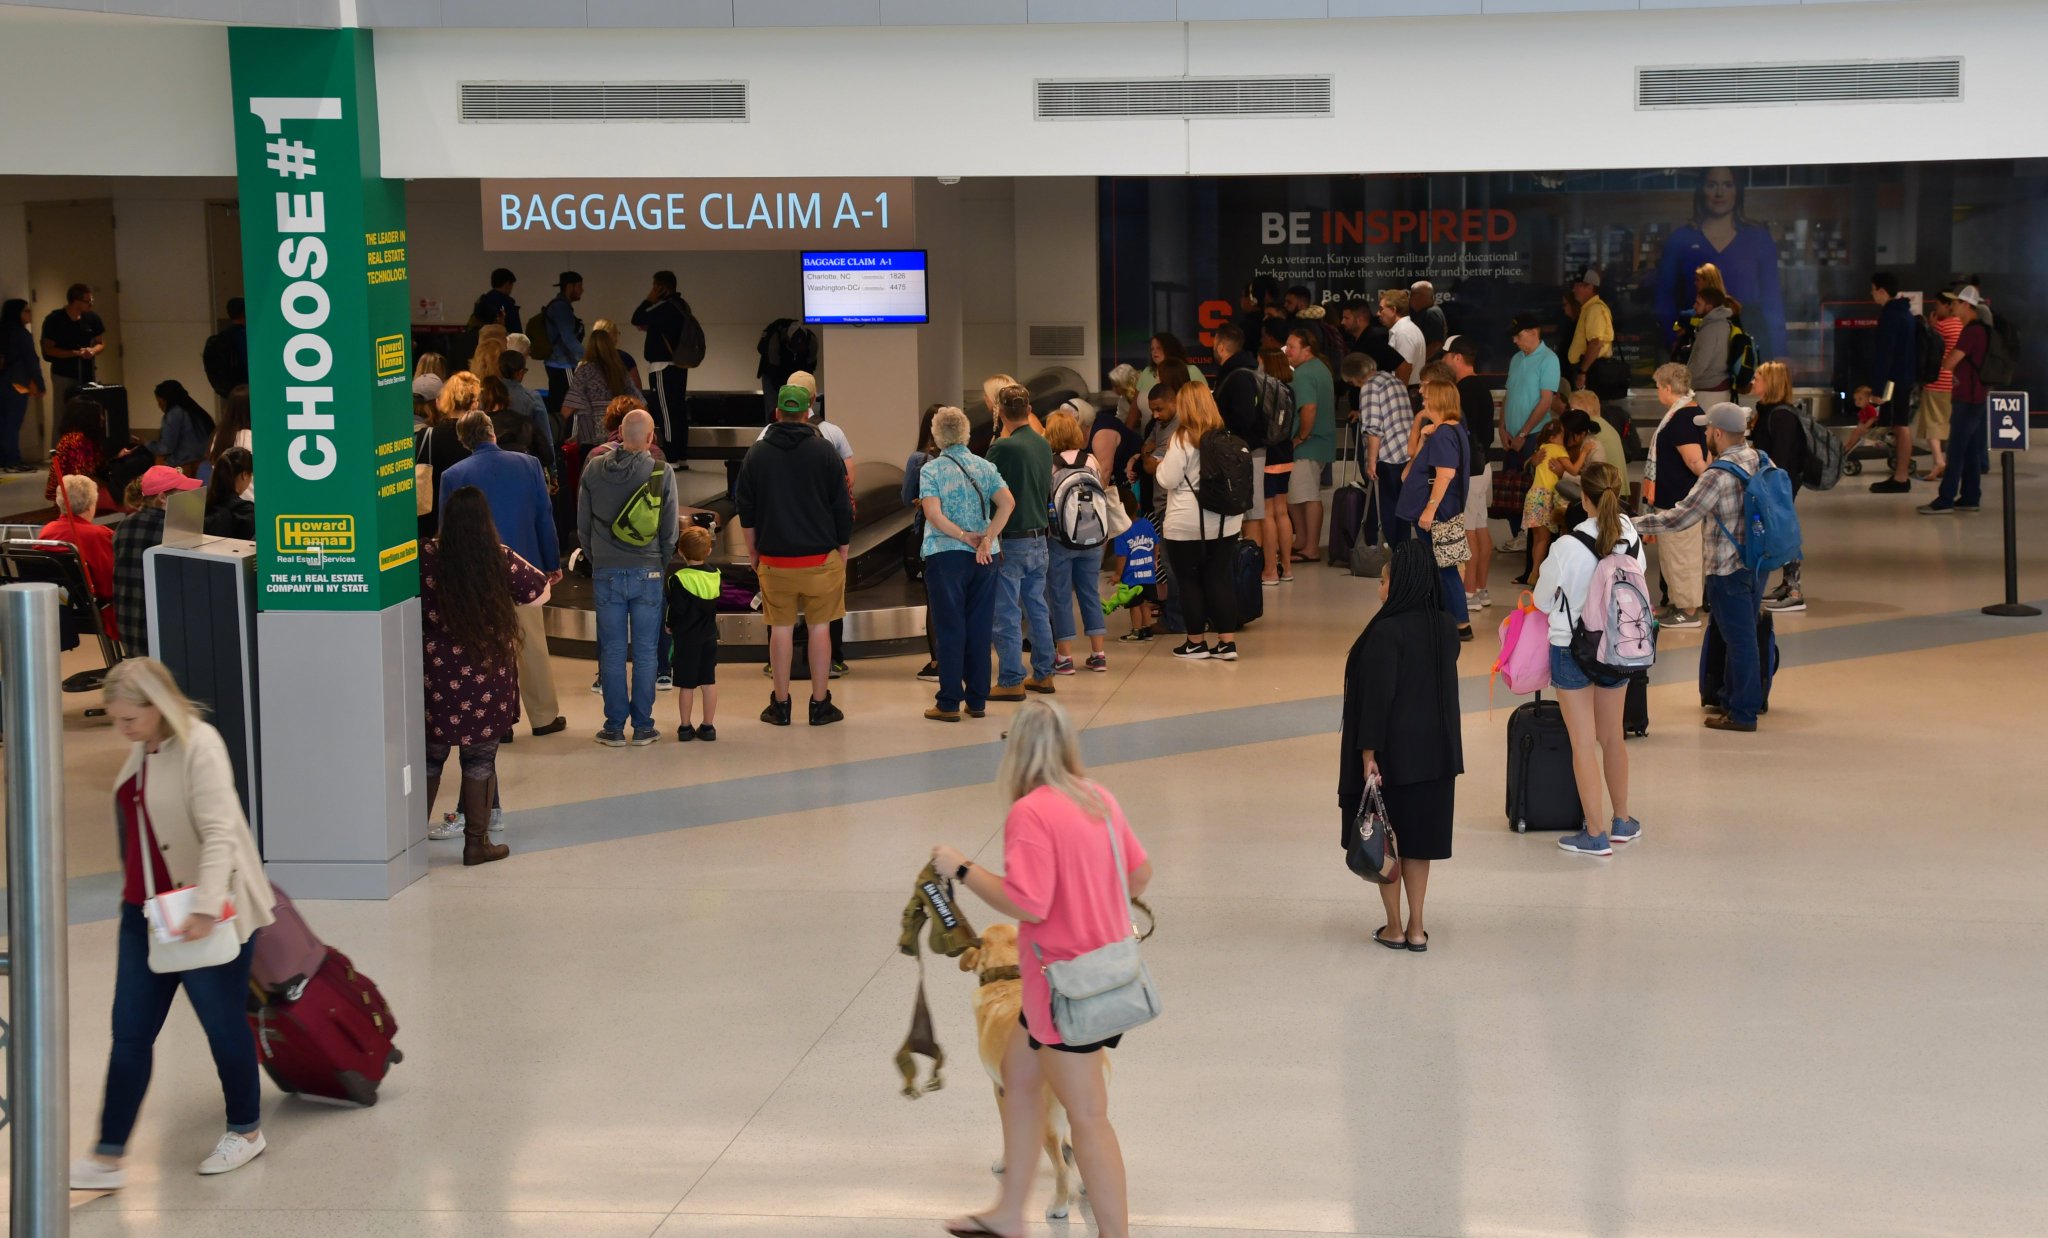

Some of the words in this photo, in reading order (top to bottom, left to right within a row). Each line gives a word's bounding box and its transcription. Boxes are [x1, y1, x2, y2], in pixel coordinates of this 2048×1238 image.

[250, 97, 342, 179] #1
[500, 193, 686, 230] BAGGAGE
[700, 192, 822, 230] CLAIM
[833, 192, 889, 229] A-1
[1261, 212, 1311, 245] BE
[1322, 209, 1517, 244] INSPIRED
[365, 233, 377, 245] THE
[378, 231, 399, 244] LEADER
[400, 230, 406, 242] IN
[368, 251, 383, 265] REAL
[384, 249, 405, 263] ESTATE
[804, 258, 846, 266] BAGGAGE
[847, 258, 876, 266] CLAIM
[880, 258, 893, 266] A-1
[1261, 254, 1276, 265] As
[1285, 256, 1325, 266] veteran,
[1327, 254, 1351, 267] Katy
[1377, 253, 1394, 263] her
[1396, 253, 1435, 267] military
[1437, 253, 1457, 263] and
[1458, 252, 1518, 263] educational
[367, 268, 407, 284] TECHNOLOGY.
[807, 273, 839, 281] Charlotte,
[1316, 270, 1326, 278] to
[1328, 268, 1356, 278] make
[1357, 268, 1374, 278] the
[1375, 267, 1405, 278] world
[1415, 267, 1440, 277] safer
[1441, 267, 1461, 277] and
[1462, 266, 1492, 277] better
[1494, 266, 1524, 279] place.
[1322, 290, 1340, 303] Be
[276, 192, 337, 480] CHOOSE
[1992, 398, 2020, 411] TAXI
[379, 442, 393, 456] MORE
[394, 437, 413, 452] BUYERS
[380, 462, 394, 477] MORE
[395, 458, 413, 472] OFFERS
[381, 484, 396, 497] MORE
[396, 478, 413, 493] MONEY
[284, 520, 347, 539] Howard
[270, 574, 288, 582] THE
[291, 574, 302, 582] #1
[305, 574, 328, 582] REAL
[331, 574, 364, 582] ESTATE
[266, 585, 311, 593] COMPANY
[314, 585, 324, 593] IN
[326, 585, 340, 593] NY
[342, 585, 369, 593] STATE
